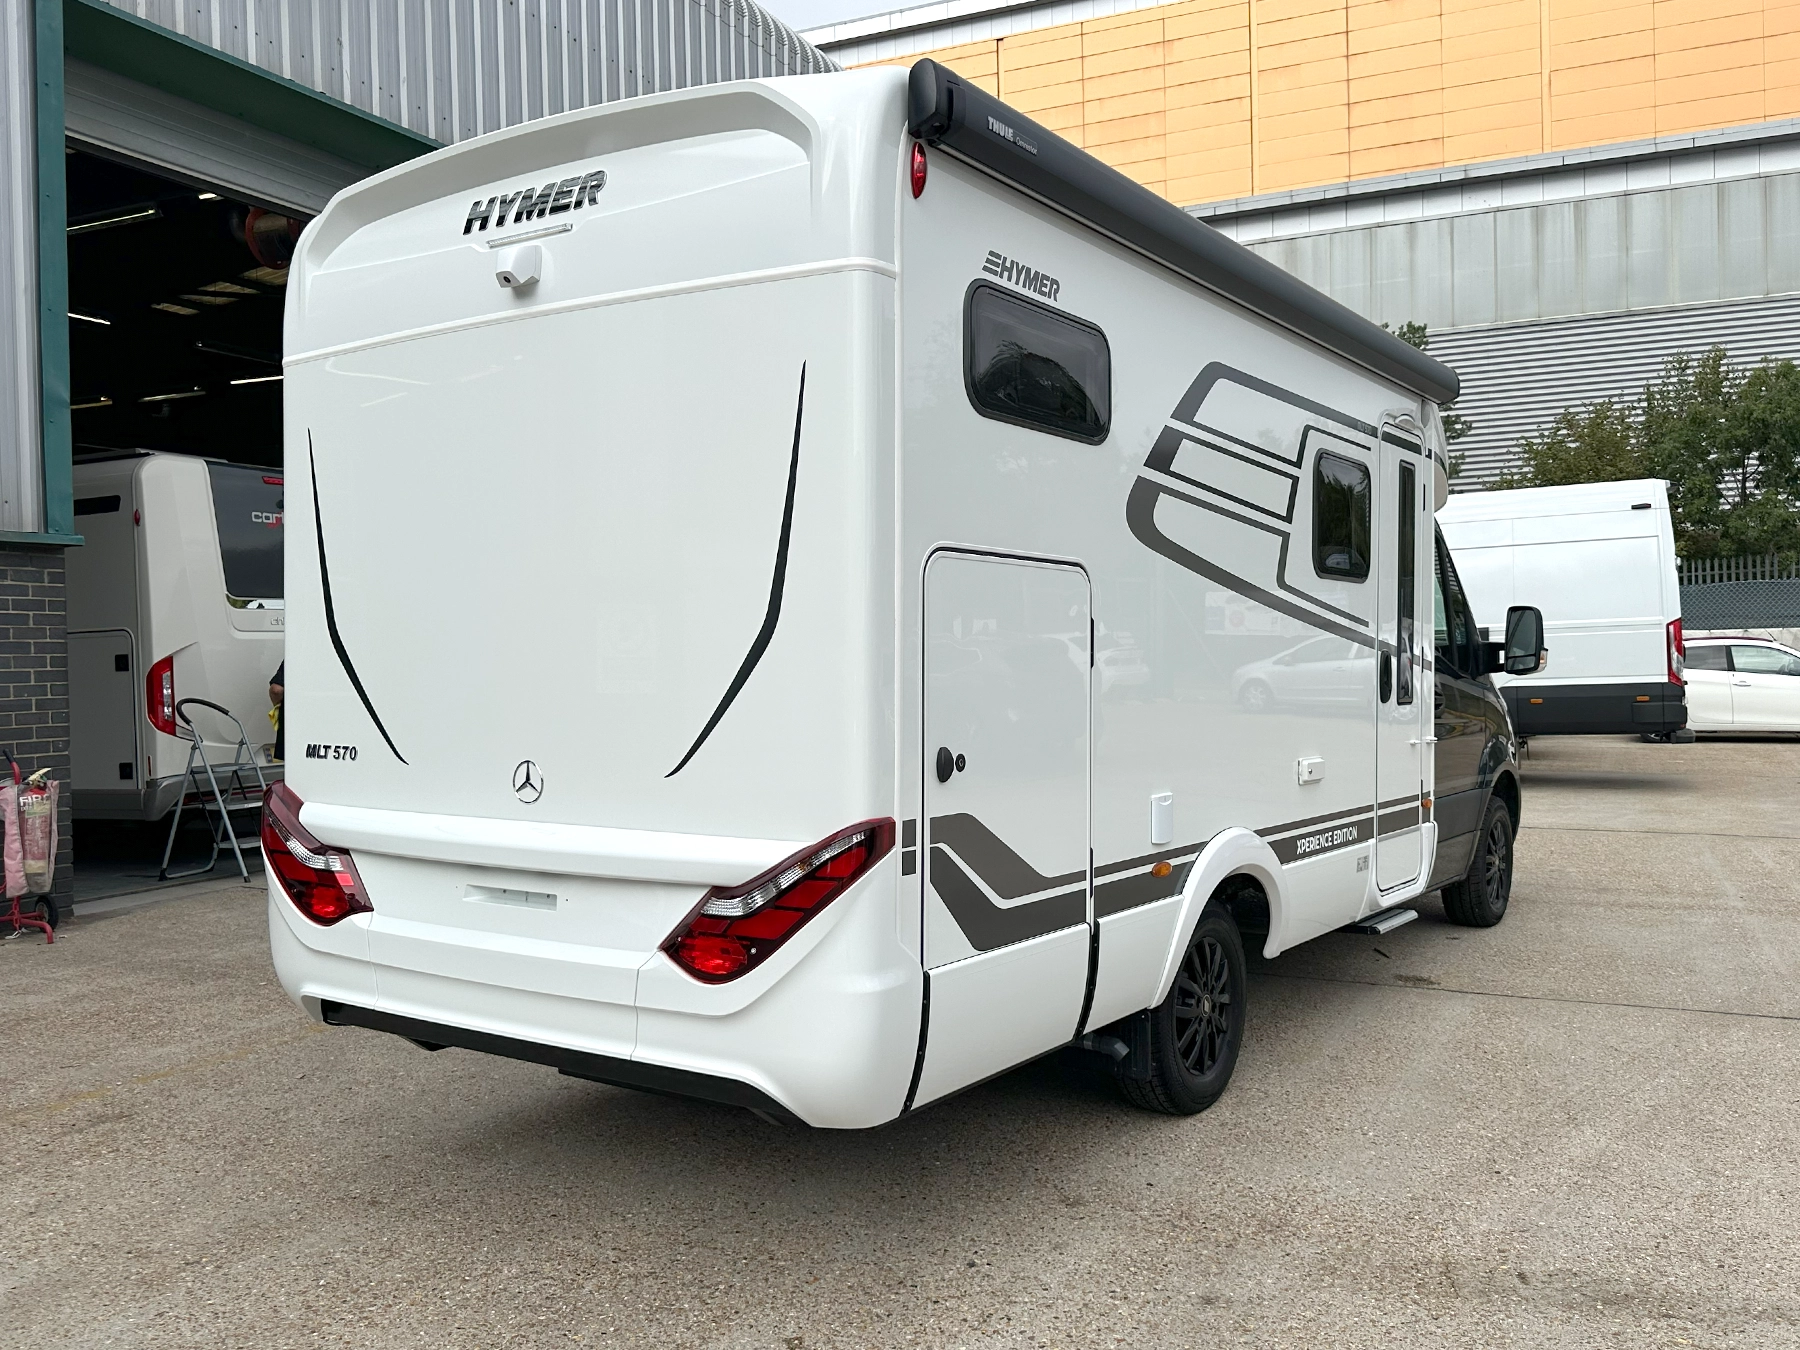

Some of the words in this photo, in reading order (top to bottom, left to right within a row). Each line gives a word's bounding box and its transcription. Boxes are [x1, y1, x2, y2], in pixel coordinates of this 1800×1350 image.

[987, 115, 1014, 142] THULE
[463, 170, 607, 236] HYMER
[998, 255, 1061, 302] HYMER
[305, 743, 332, 760] MLT
[333, 746, 359, 761] 570
[1296, 832, 1332, 855] XPERIENCE
[1333, 825, 1358, 845] EDITION
